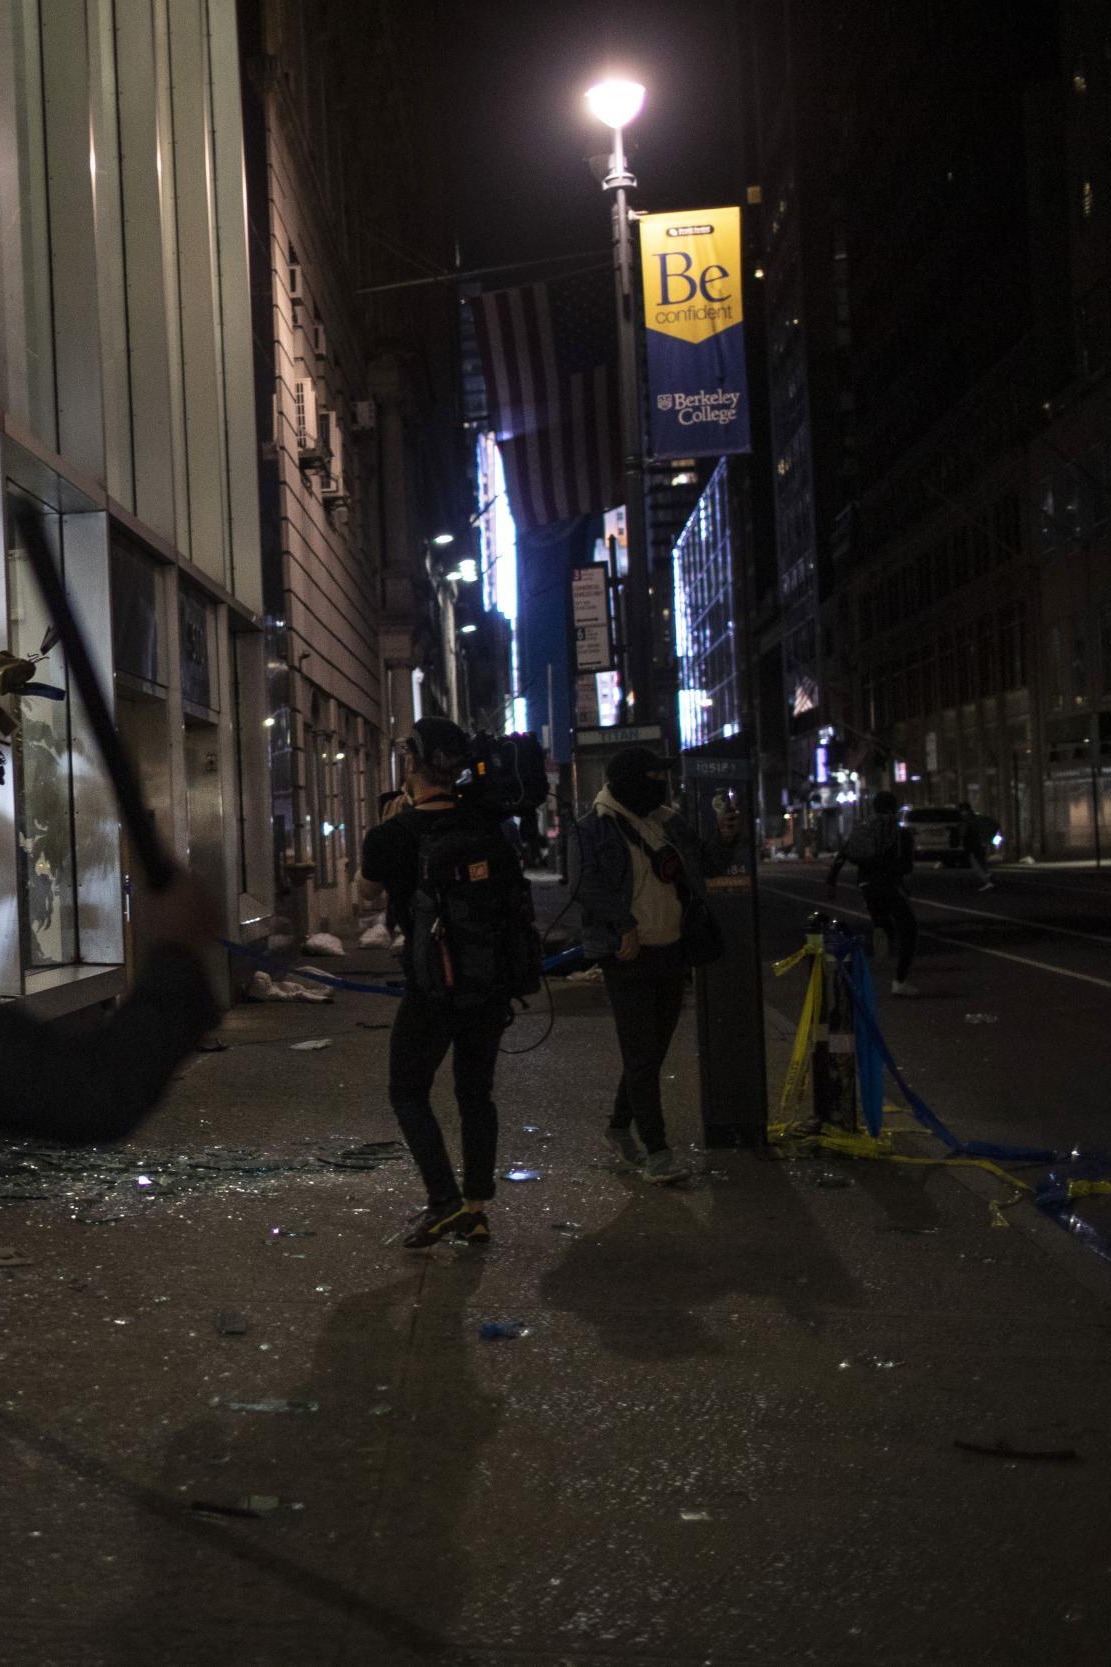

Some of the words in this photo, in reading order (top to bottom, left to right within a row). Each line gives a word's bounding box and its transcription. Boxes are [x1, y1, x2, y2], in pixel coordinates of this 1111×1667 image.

[652, 251, 732, 306] Be
[655, 304, 733, 324] confident
[673, 388, 740, 410] Berkeley
[678, 406, 737, 425] College
